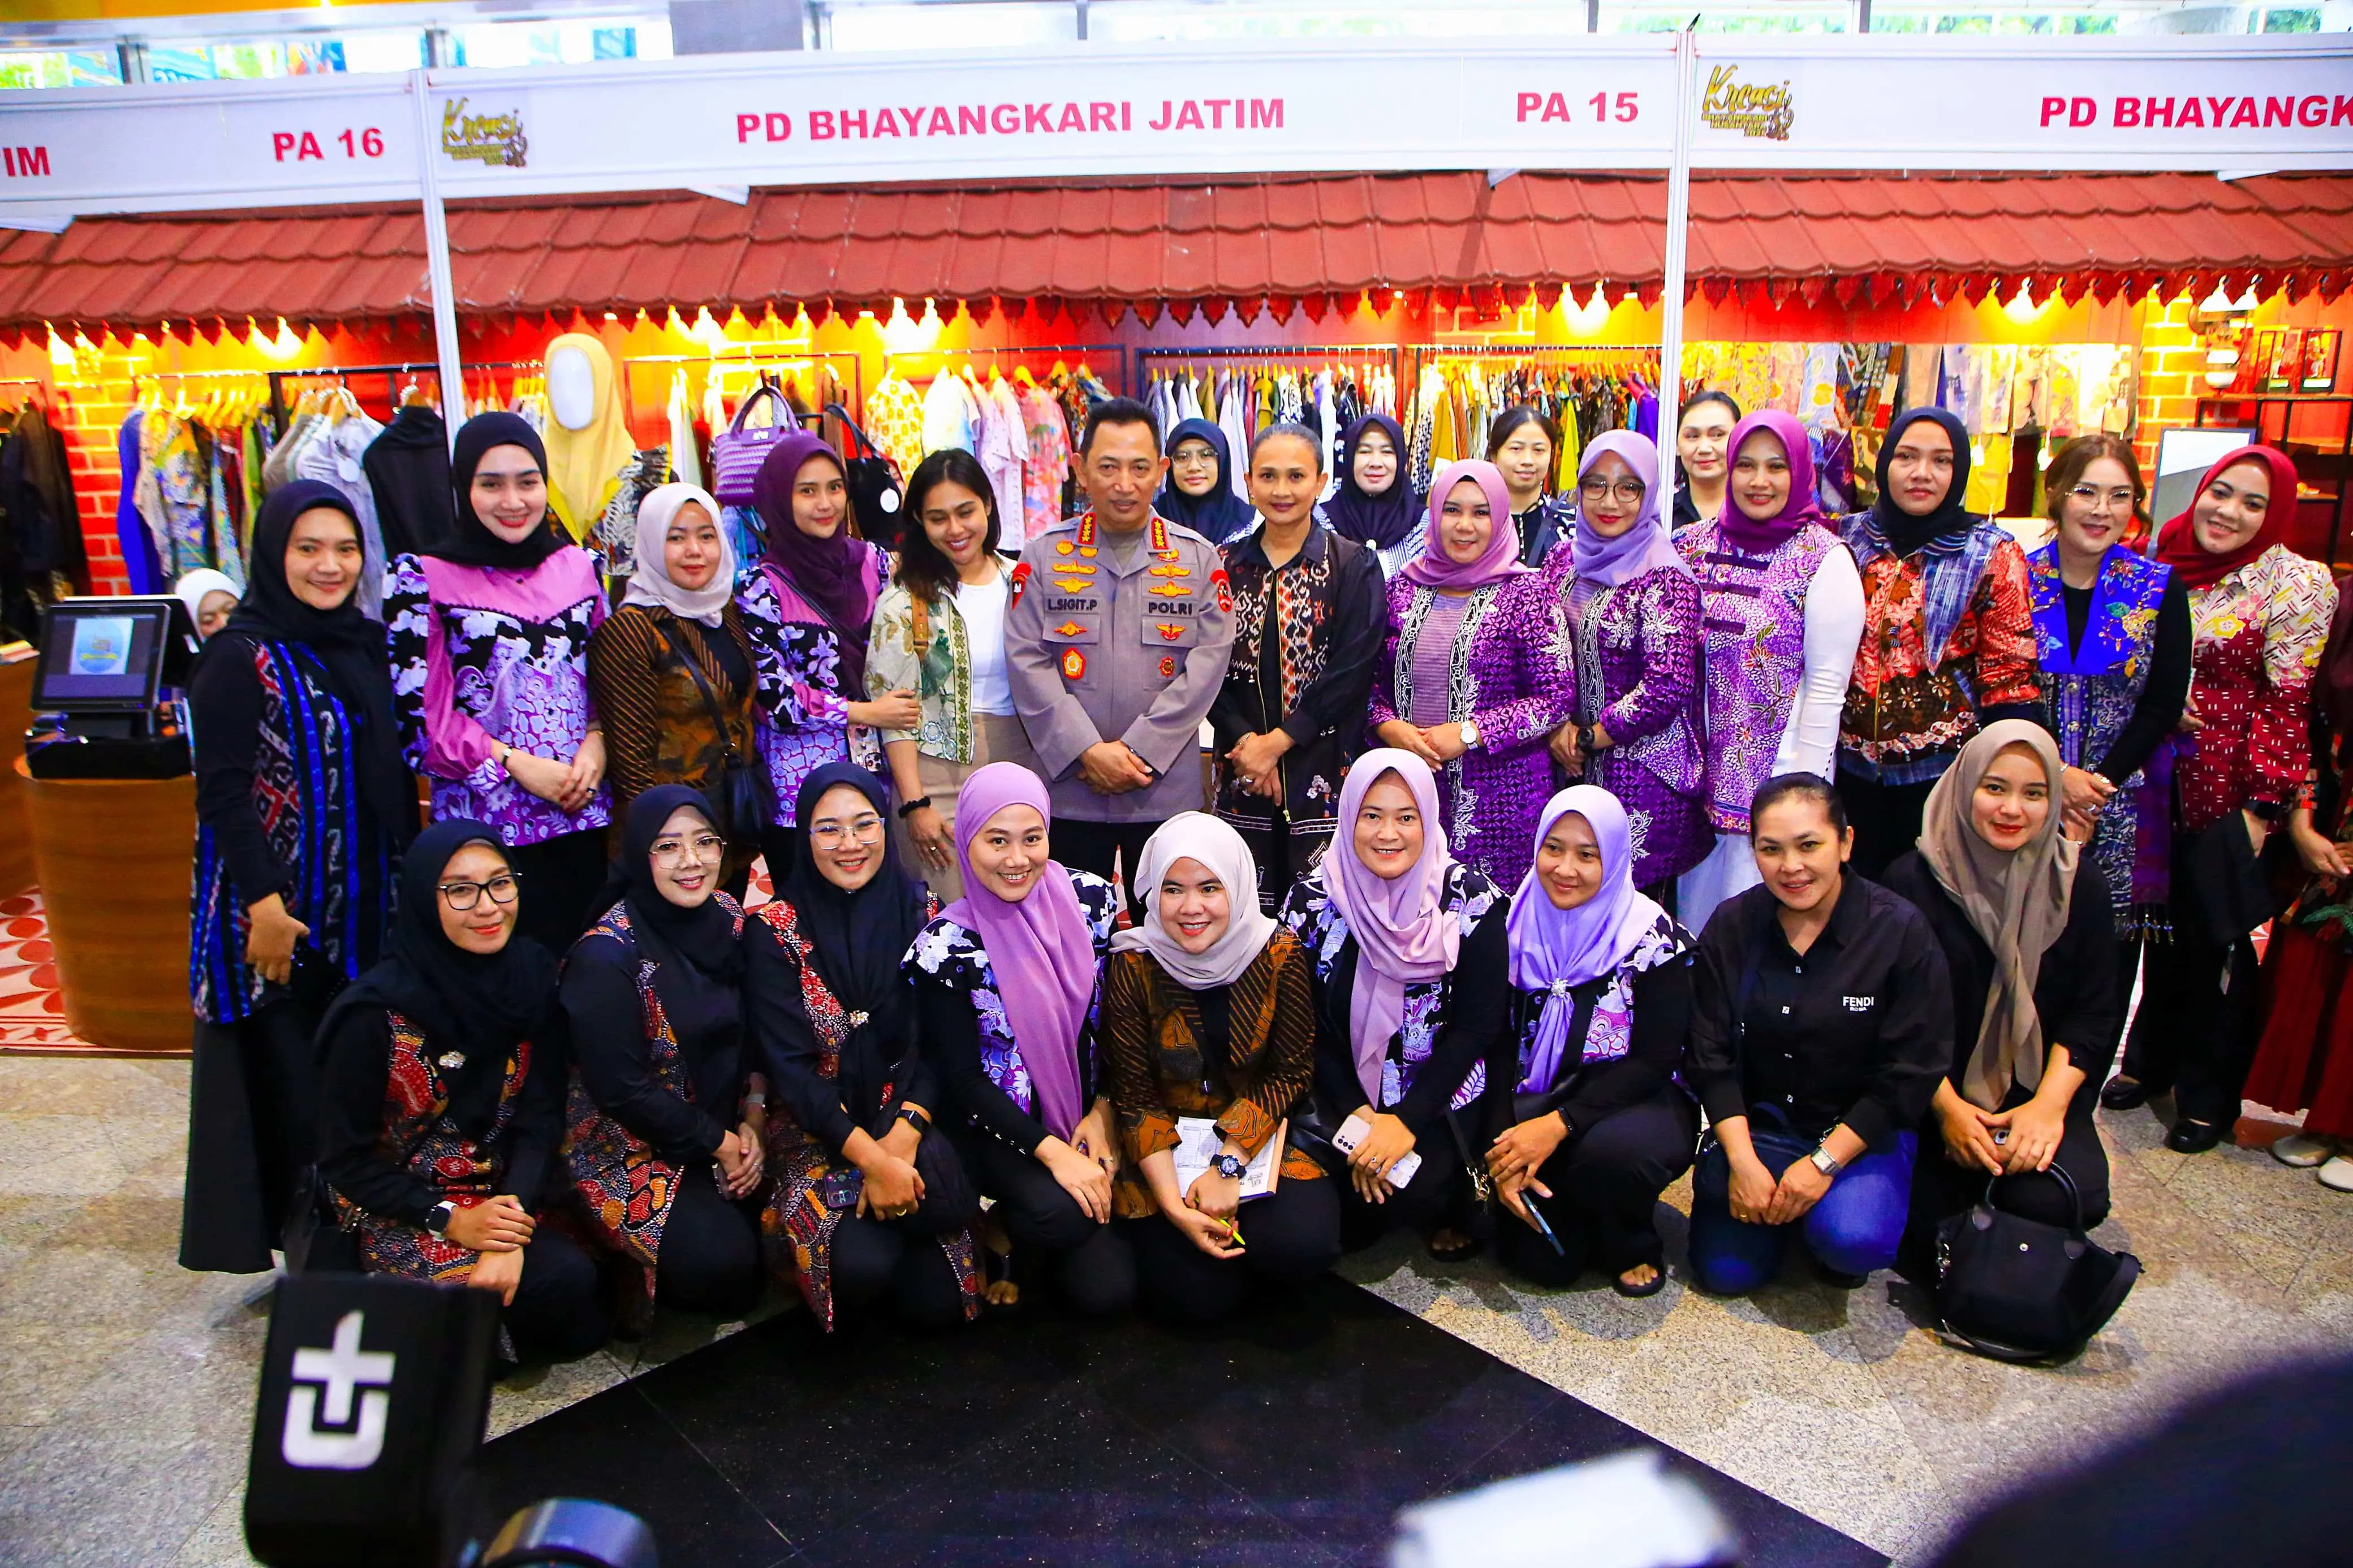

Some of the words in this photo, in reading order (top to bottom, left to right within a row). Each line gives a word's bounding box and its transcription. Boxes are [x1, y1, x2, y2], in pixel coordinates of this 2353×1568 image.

[1702, 64, 1791, 112] Kreasi
[736, 113, 792, 144] PD
[809, 101, 1131, 141] BHAYANGKARI
[1149, 98, 1283, 131] JATIM
[1517, 92, 1571, 123] PA
[1589, 92, 1638, 123] 15
[2039, 97, 2097, 128] PD
[2113, 95, 2353, 128] BHAYANGK
[272, 131, 324, 162] PA
[338, 128, 385, 159] 16
[0, 146, 51, 177] IM
[1048, 598, 1098, 611] L.SIGIT.P
[1148, 602, 1193, 615] POLRI
[1843, 996, 1874, 1007] FENDI
